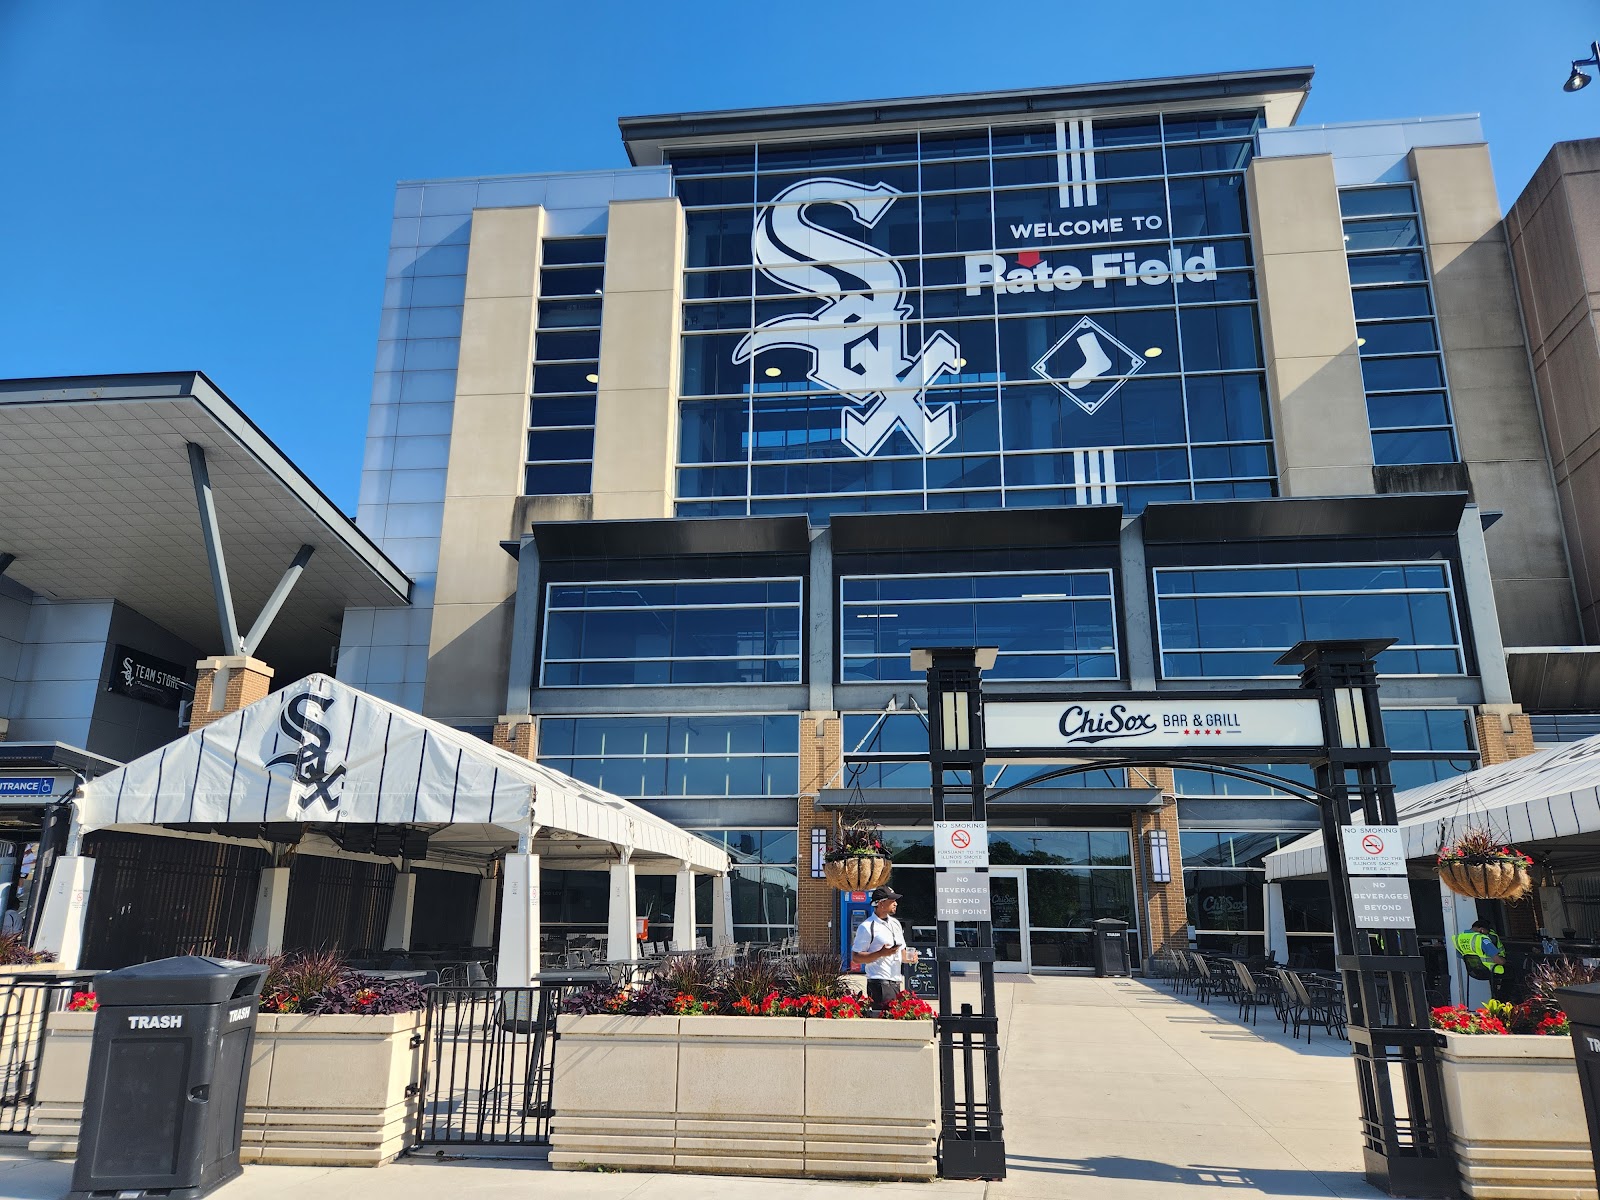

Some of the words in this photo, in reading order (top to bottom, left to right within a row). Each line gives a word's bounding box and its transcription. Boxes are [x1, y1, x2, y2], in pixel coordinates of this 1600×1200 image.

[1010, 217, 1124, 239] WELCOME
[1131, 215, 1163, 231] TO
[964, 254, 1083, 297] Rate
[1091, 246, 1218, 289] Field
[135, 664, 157, 683] TEAM
[156, 671, 181, 690] STORE
[1058, 704, 1157, 744] ChiSox
[1163, 714, 1188, 727] BAR
[1193, 714, 1203, 727] &
[1206, 714, 1241, 727] GRILL
[128, 1015, 182, 1030] TRASH
[229, 1006, 251, 1024] TRASH
[1586, 1036, 1600, 1053] TR
